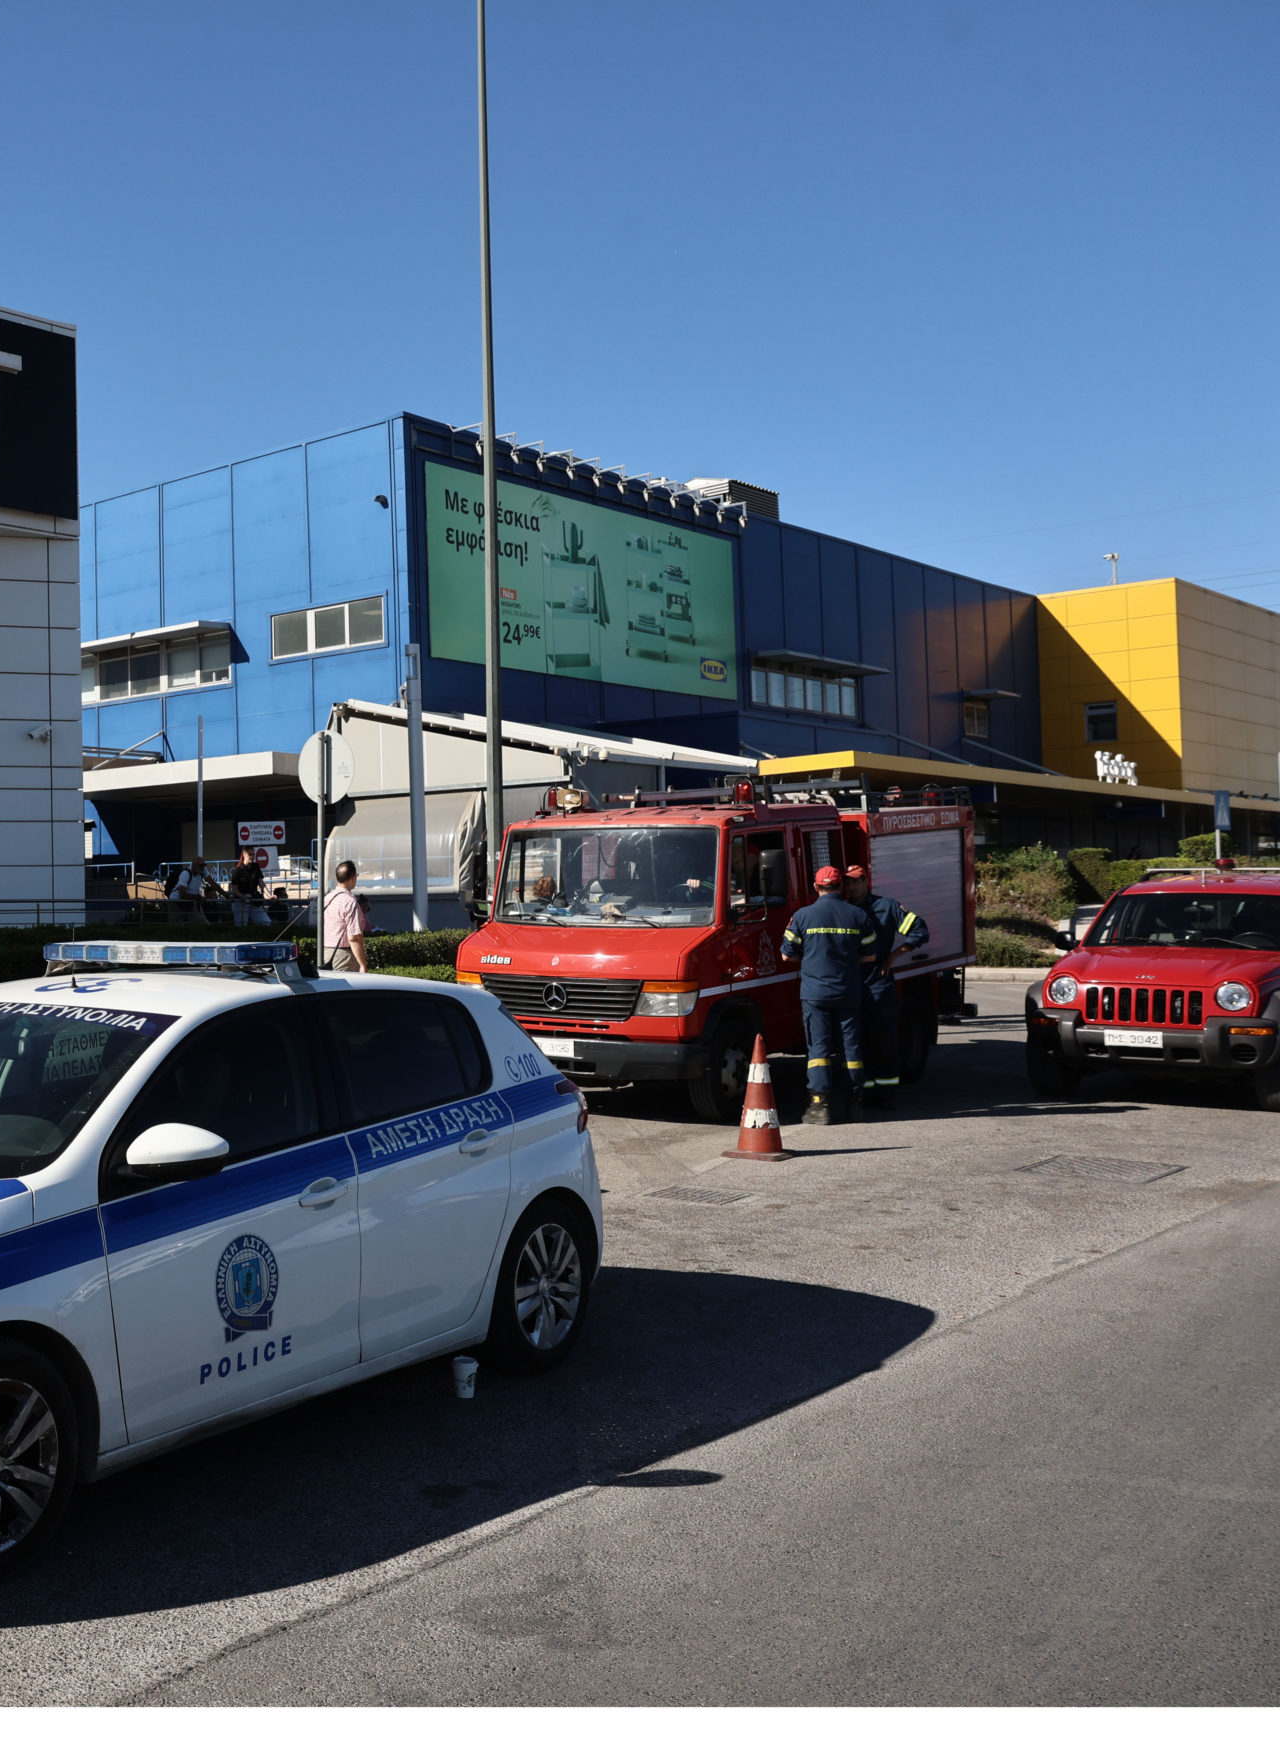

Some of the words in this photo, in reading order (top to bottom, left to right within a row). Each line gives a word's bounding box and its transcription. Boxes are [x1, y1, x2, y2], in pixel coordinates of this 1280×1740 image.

[444, 488, 470, 515] Με
[473, 500, 541, 533] φέσκια
[445, 527, 528, 567] εμφάιση!
[703, 663, 726, 676] IKEA
[883, 812, 936, 830] ΠΥΡΟΣΒΕΣΤΙΚΟ
[941, 810, 960, 825] ΣΩΜΑ
[480, 954, 512, 965] sides
[1130, 1034, 1158, 1045] 3042
[518, 1053, 542, 1078] 100
[366, 1115, 442, 1159] ΑΜΕΣΗ
[439, 1098, 505, 1136] ΔΡΑΣΗ
[217, 1240, 239, 1320] ΕΛΛΗΝΙΚΗ
[243, 1235, 278, 1303] ΑΣΤΥΝΟΜΙΑ
[200, 1334, 292, 1386] POLICE
